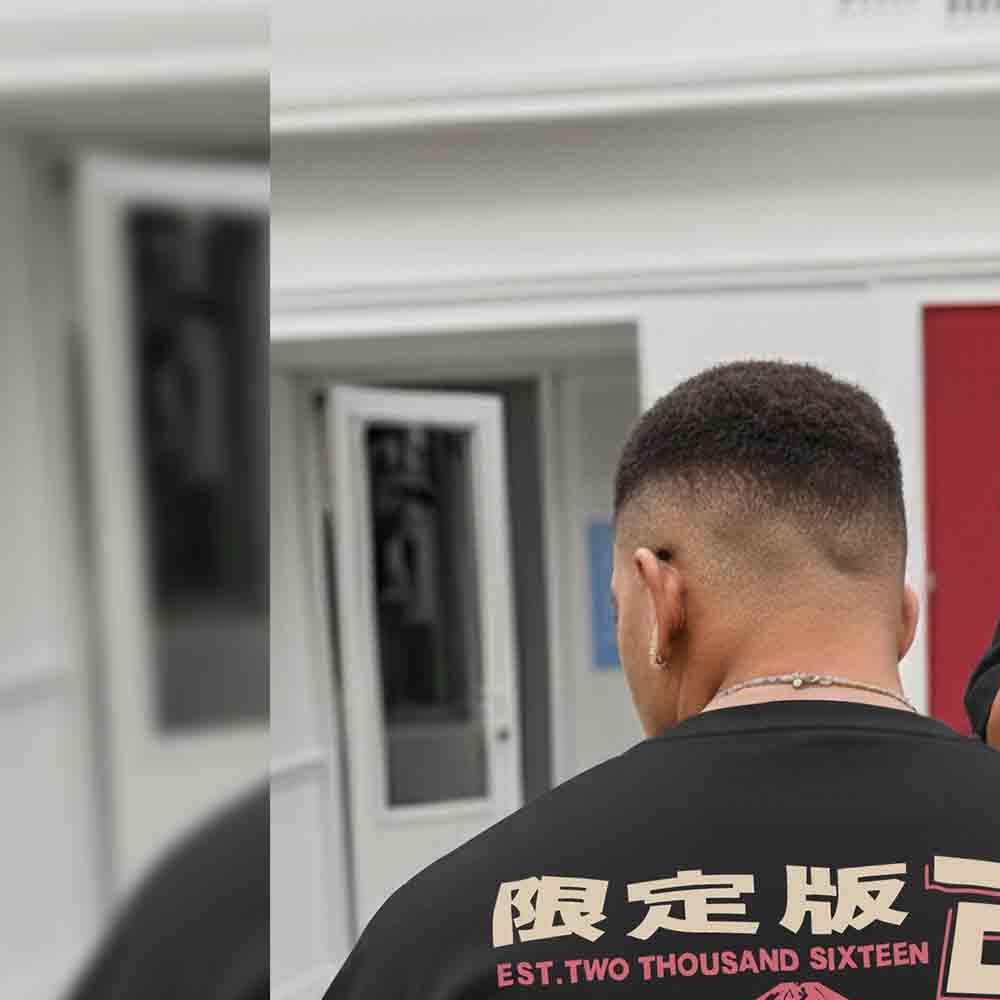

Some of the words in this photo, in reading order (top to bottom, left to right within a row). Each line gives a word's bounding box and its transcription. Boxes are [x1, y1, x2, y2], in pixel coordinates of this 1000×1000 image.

[491, 862, 910, 947] 限定版
[638, 948, 799, 980] THOUSAND
[810, 941, 929, 970] SIXTEEN
